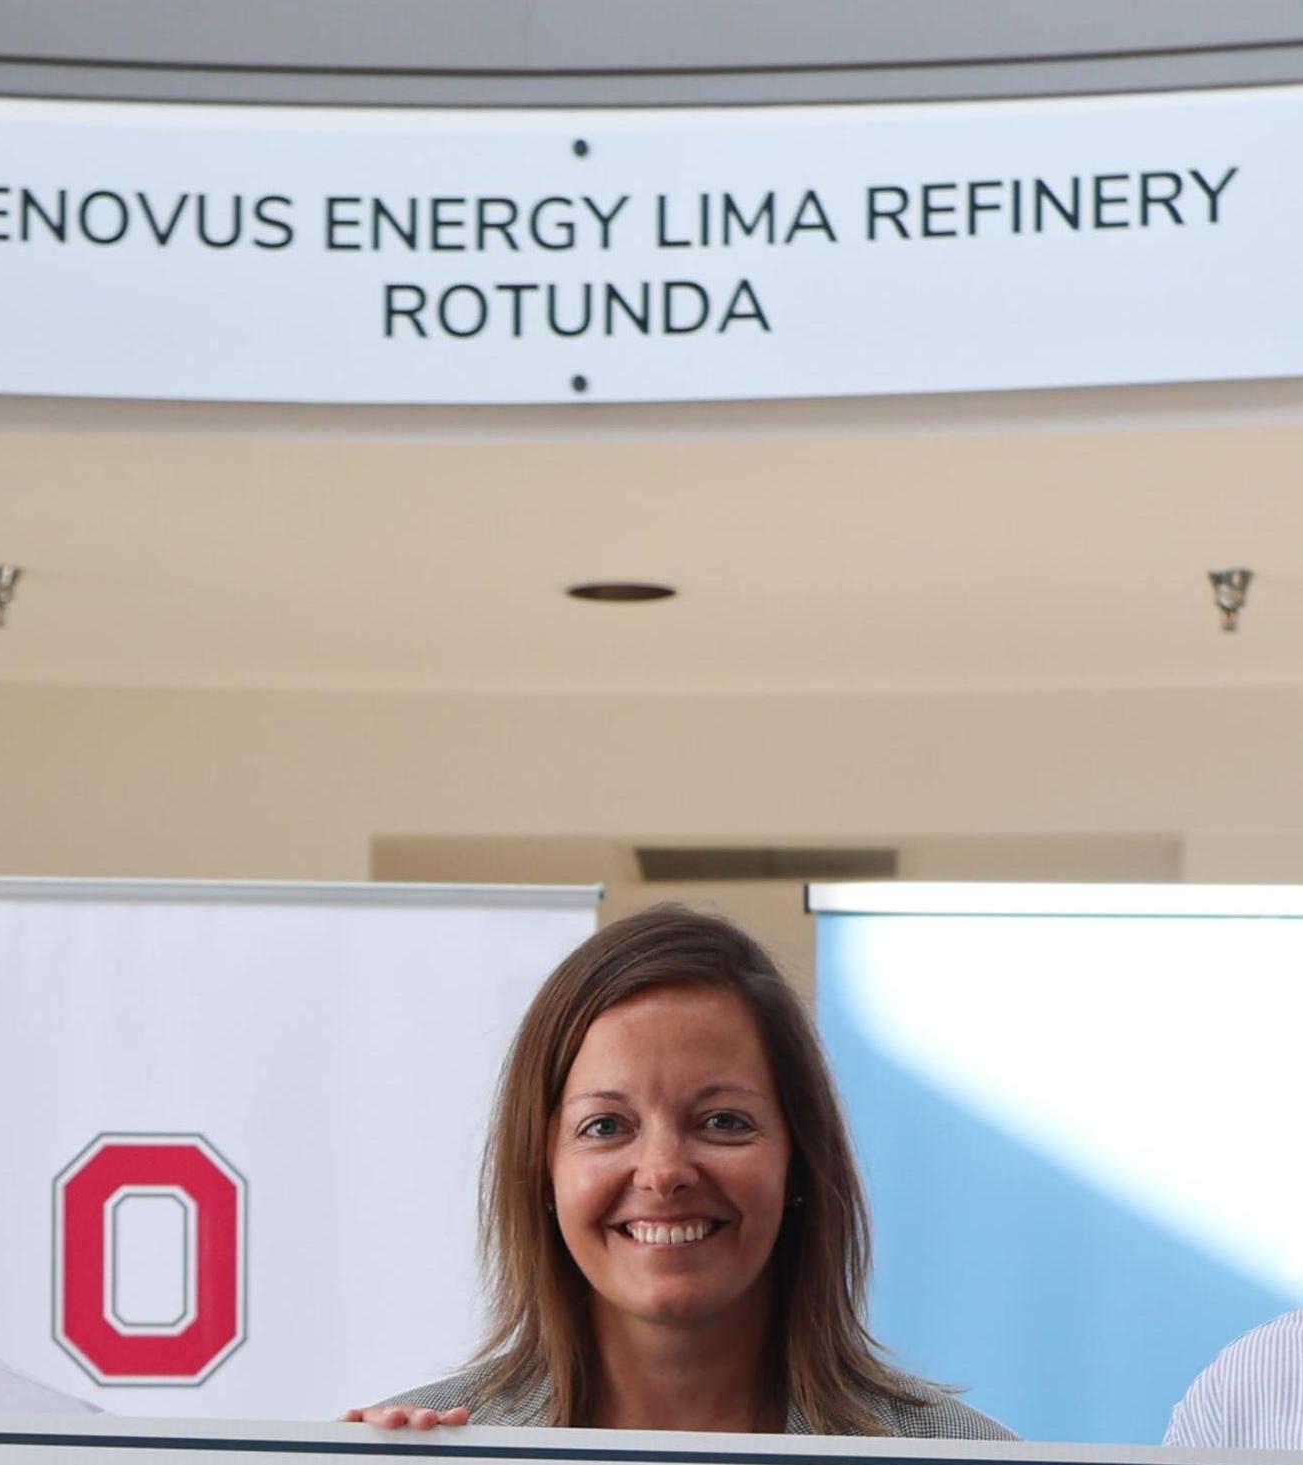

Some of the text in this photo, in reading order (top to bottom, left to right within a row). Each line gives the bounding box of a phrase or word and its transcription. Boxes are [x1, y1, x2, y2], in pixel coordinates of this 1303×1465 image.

[326, 196, 629, 251] ENERGY
[658, 190, 837, 248] LIMA
[868, 168, 1237, 240] REFINERY
[385, 280, 770, 338] ROTUNDA
